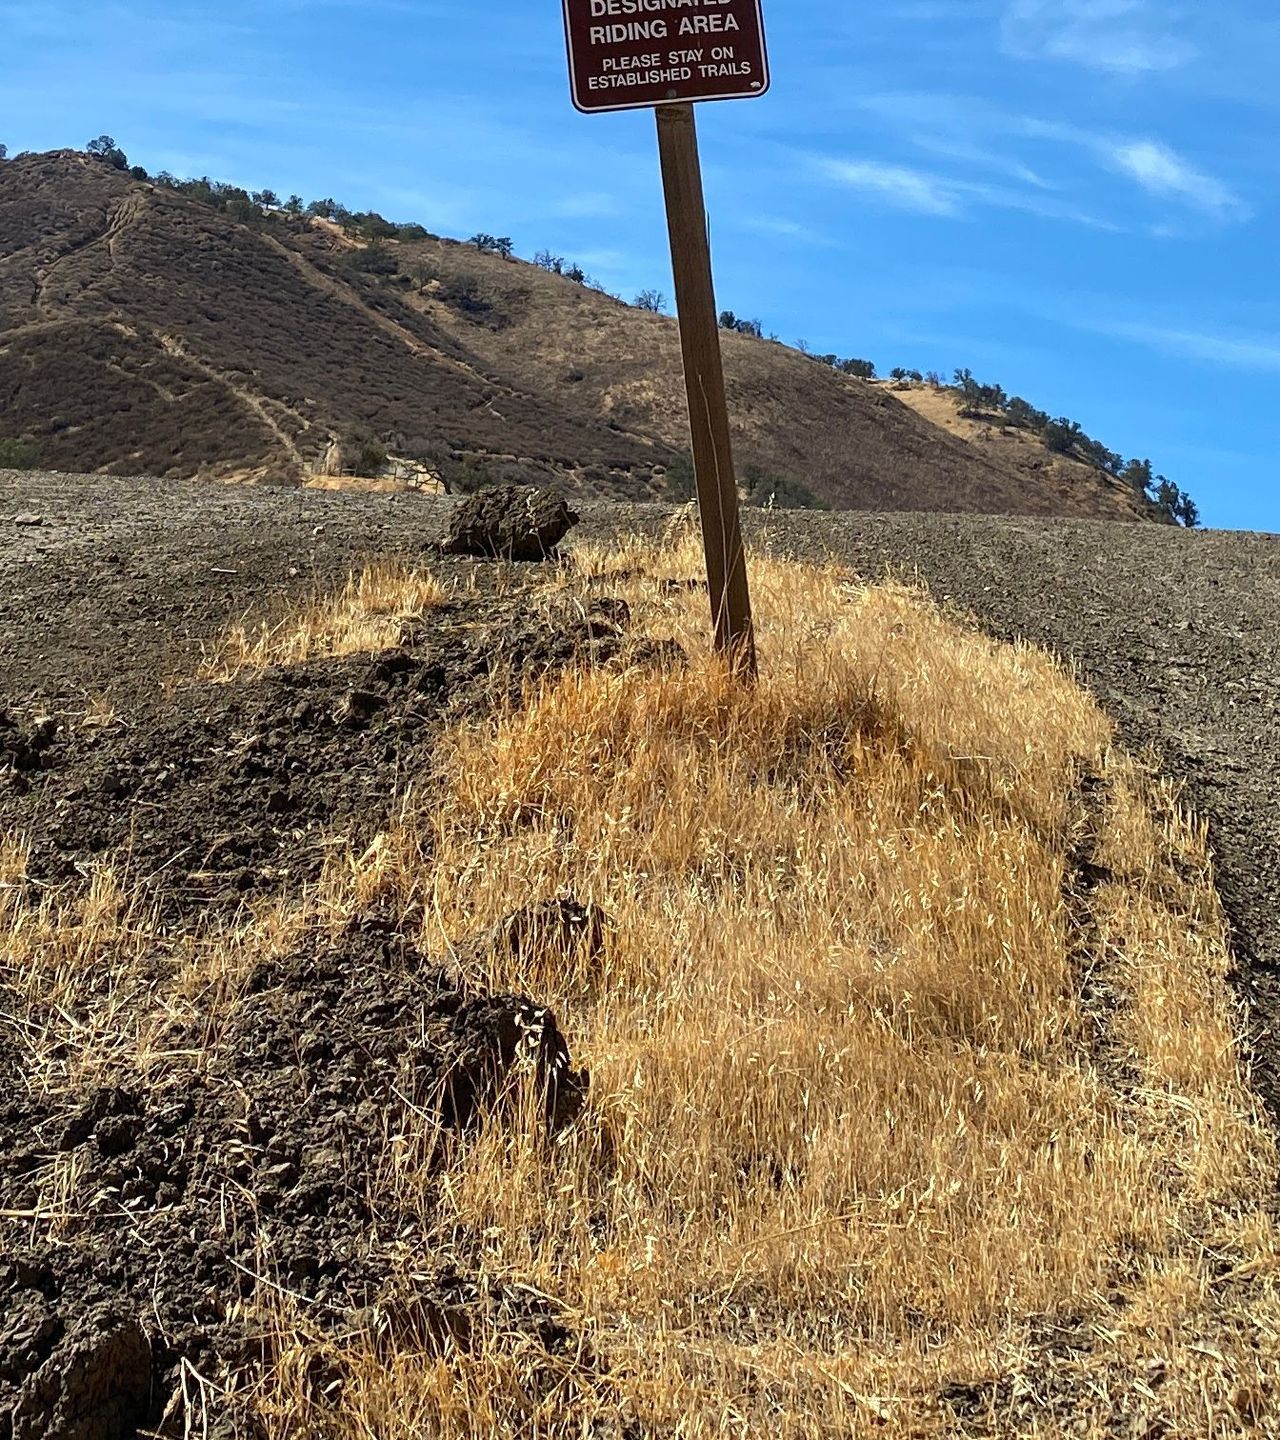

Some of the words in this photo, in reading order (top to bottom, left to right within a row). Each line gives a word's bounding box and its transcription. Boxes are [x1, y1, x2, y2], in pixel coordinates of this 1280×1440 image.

[589, 19, 667, 45] RIDING
[678, 13, 739, 36] AREA
[602, 53, 661, 71] PLEASE
[668, 48, 704, 65] STAY
[711, 46, 734, 60] ON
[588, 67, 692, 90] ESTABLISHED
[698, 61, 751, 79] TRAILS
